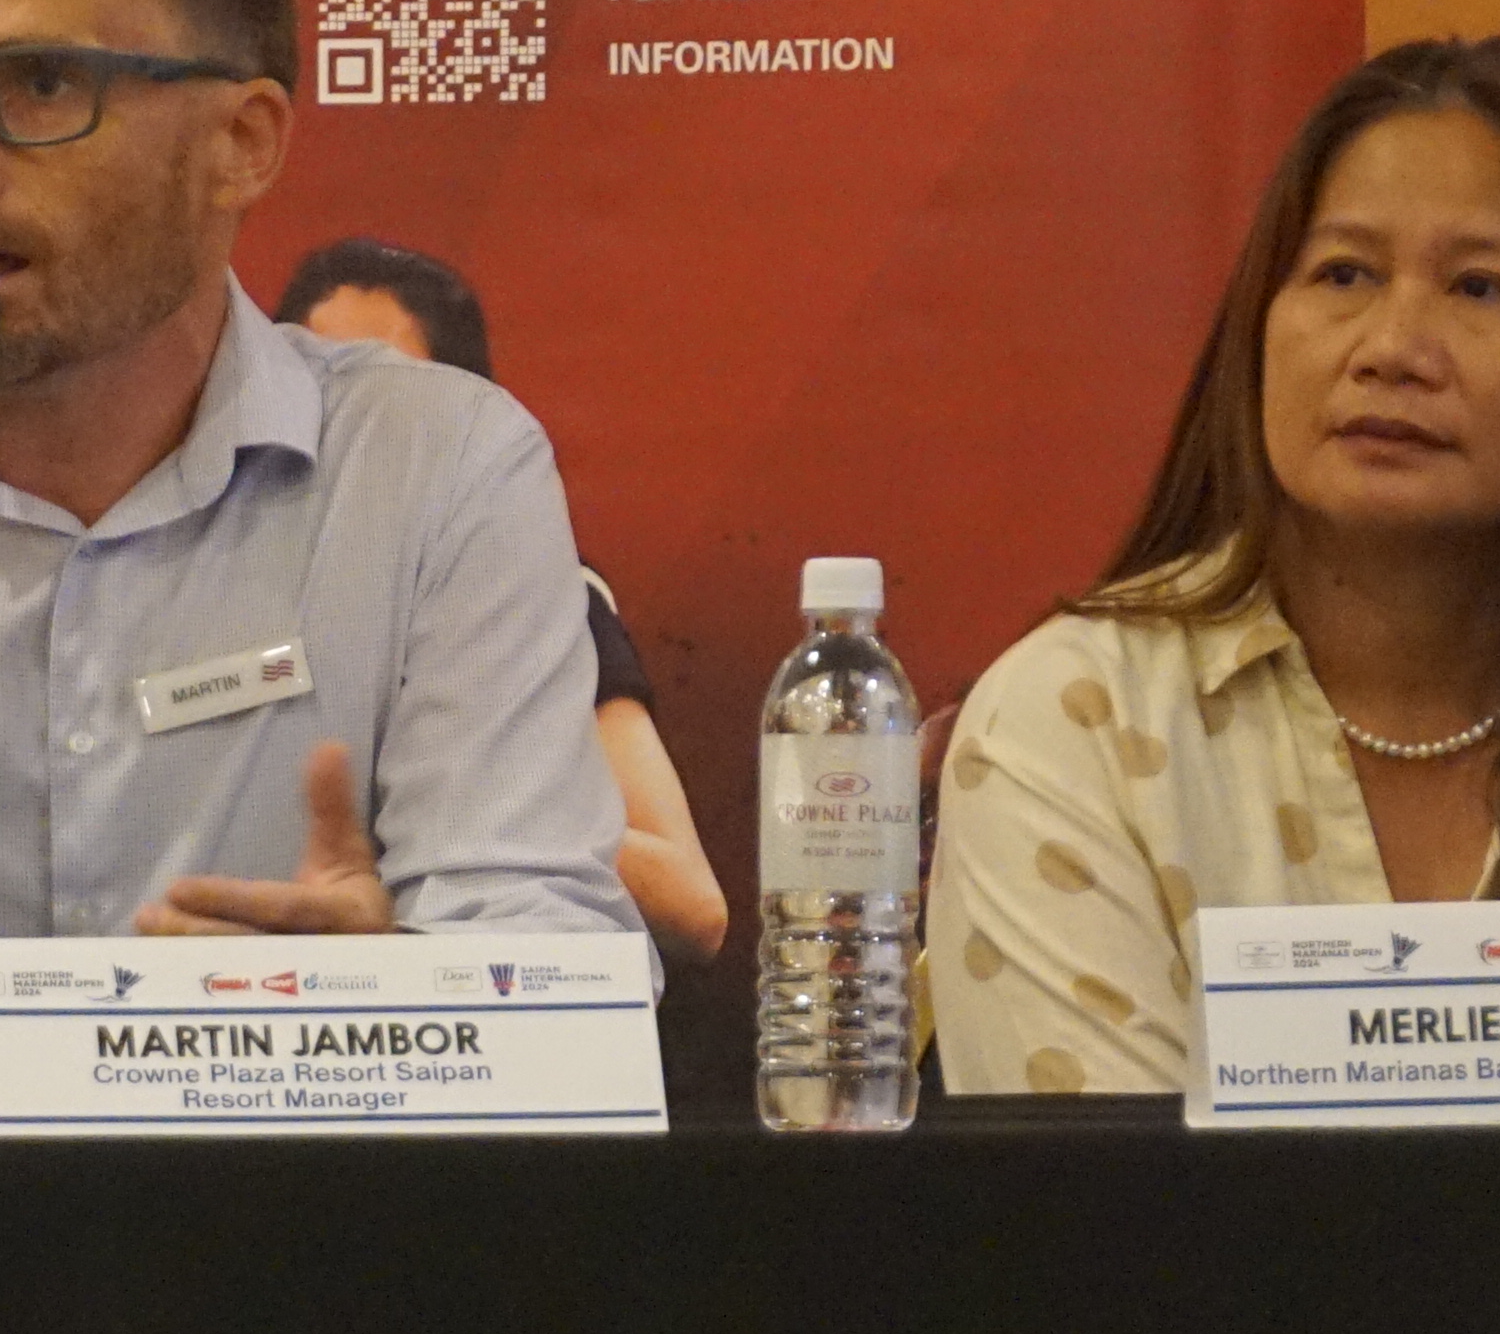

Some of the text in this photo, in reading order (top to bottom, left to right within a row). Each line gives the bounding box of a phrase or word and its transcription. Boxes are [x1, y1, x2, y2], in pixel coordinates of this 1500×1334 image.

[608, 36, 896, 76] INFORMATION
[171, 672, 242, 705] MARTIN
[96, 1020, 484, 1059] MARTIN JAMBOR
[92, 1059, 493, 1085] Crowne Plaza Resort Saipan
[1218, 1060, 1338, 1087] Northern
[1345, 1057, 1469, 1083] Marianas
[182, 1087, 408, 1112] Resort Manager
